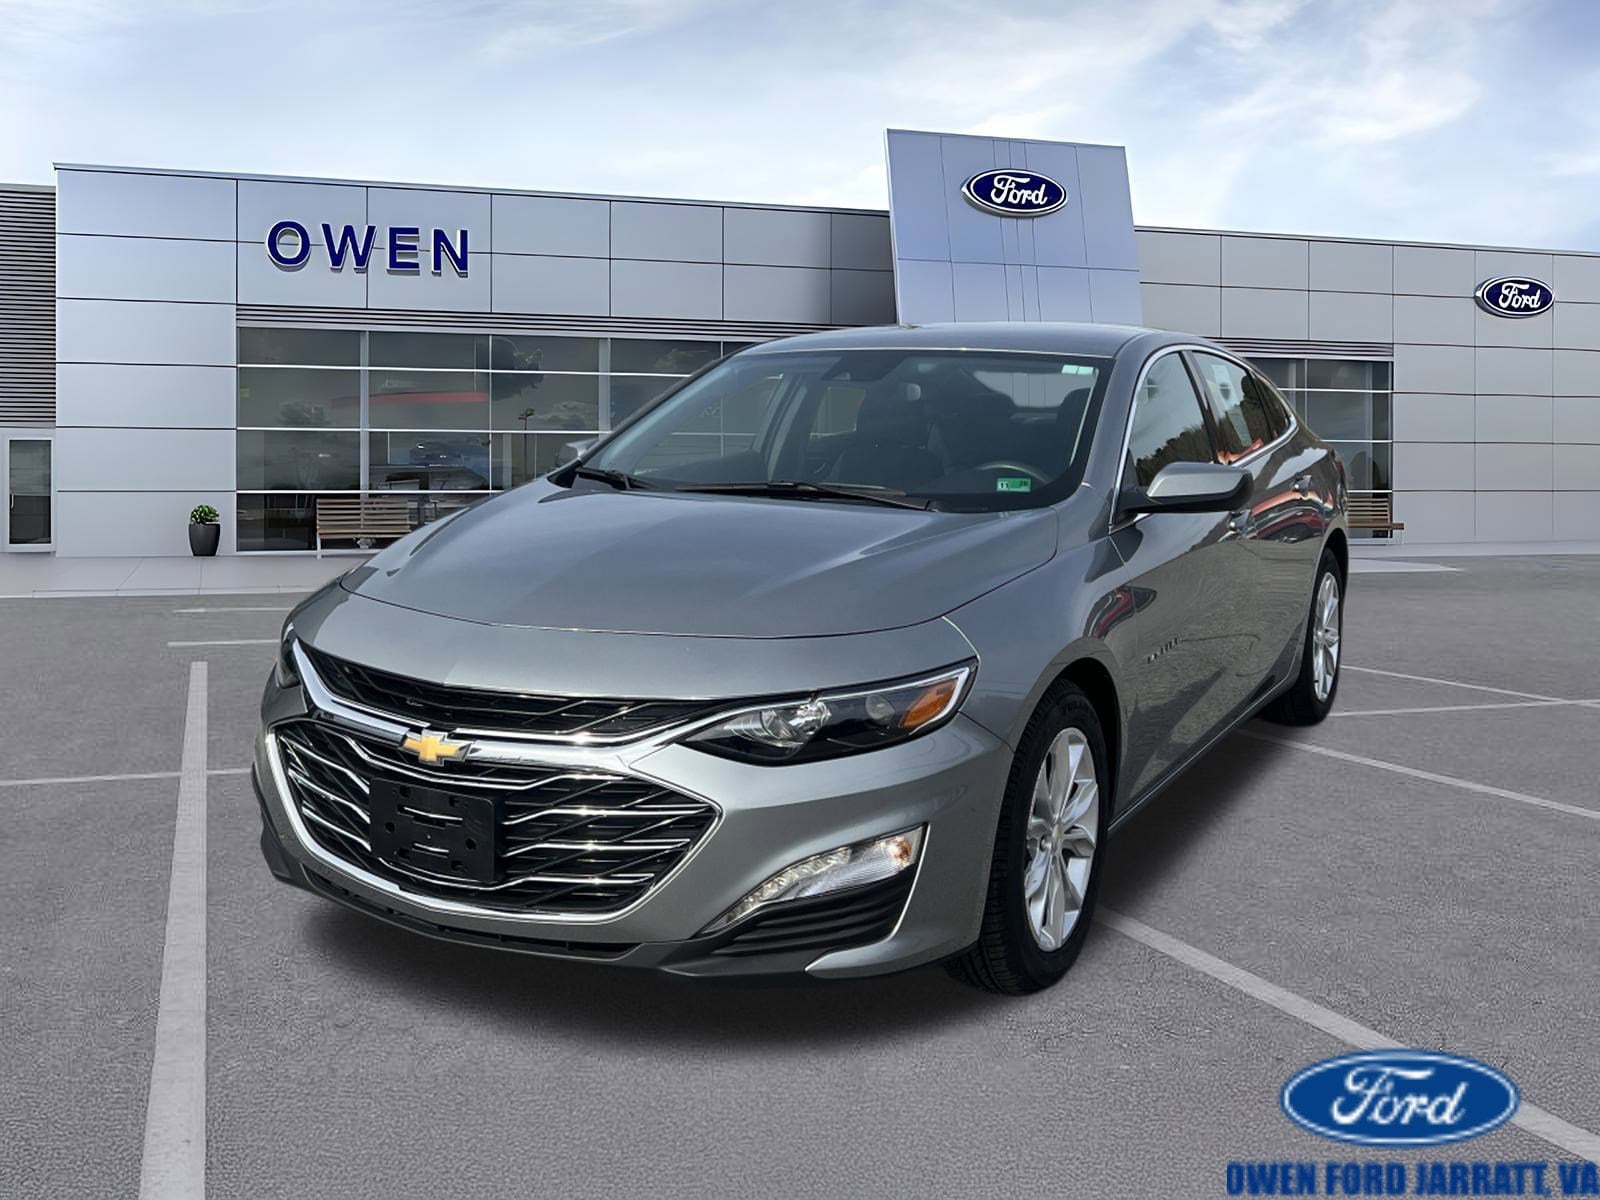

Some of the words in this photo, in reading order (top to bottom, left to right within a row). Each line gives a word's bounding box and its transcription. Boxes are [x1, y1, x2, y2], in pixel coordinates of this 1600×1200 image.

[991, 175, 1048, 205] Ford
[267, 220, 469, 277] OWEN
[1498, 282, 1541, 308] Ford
